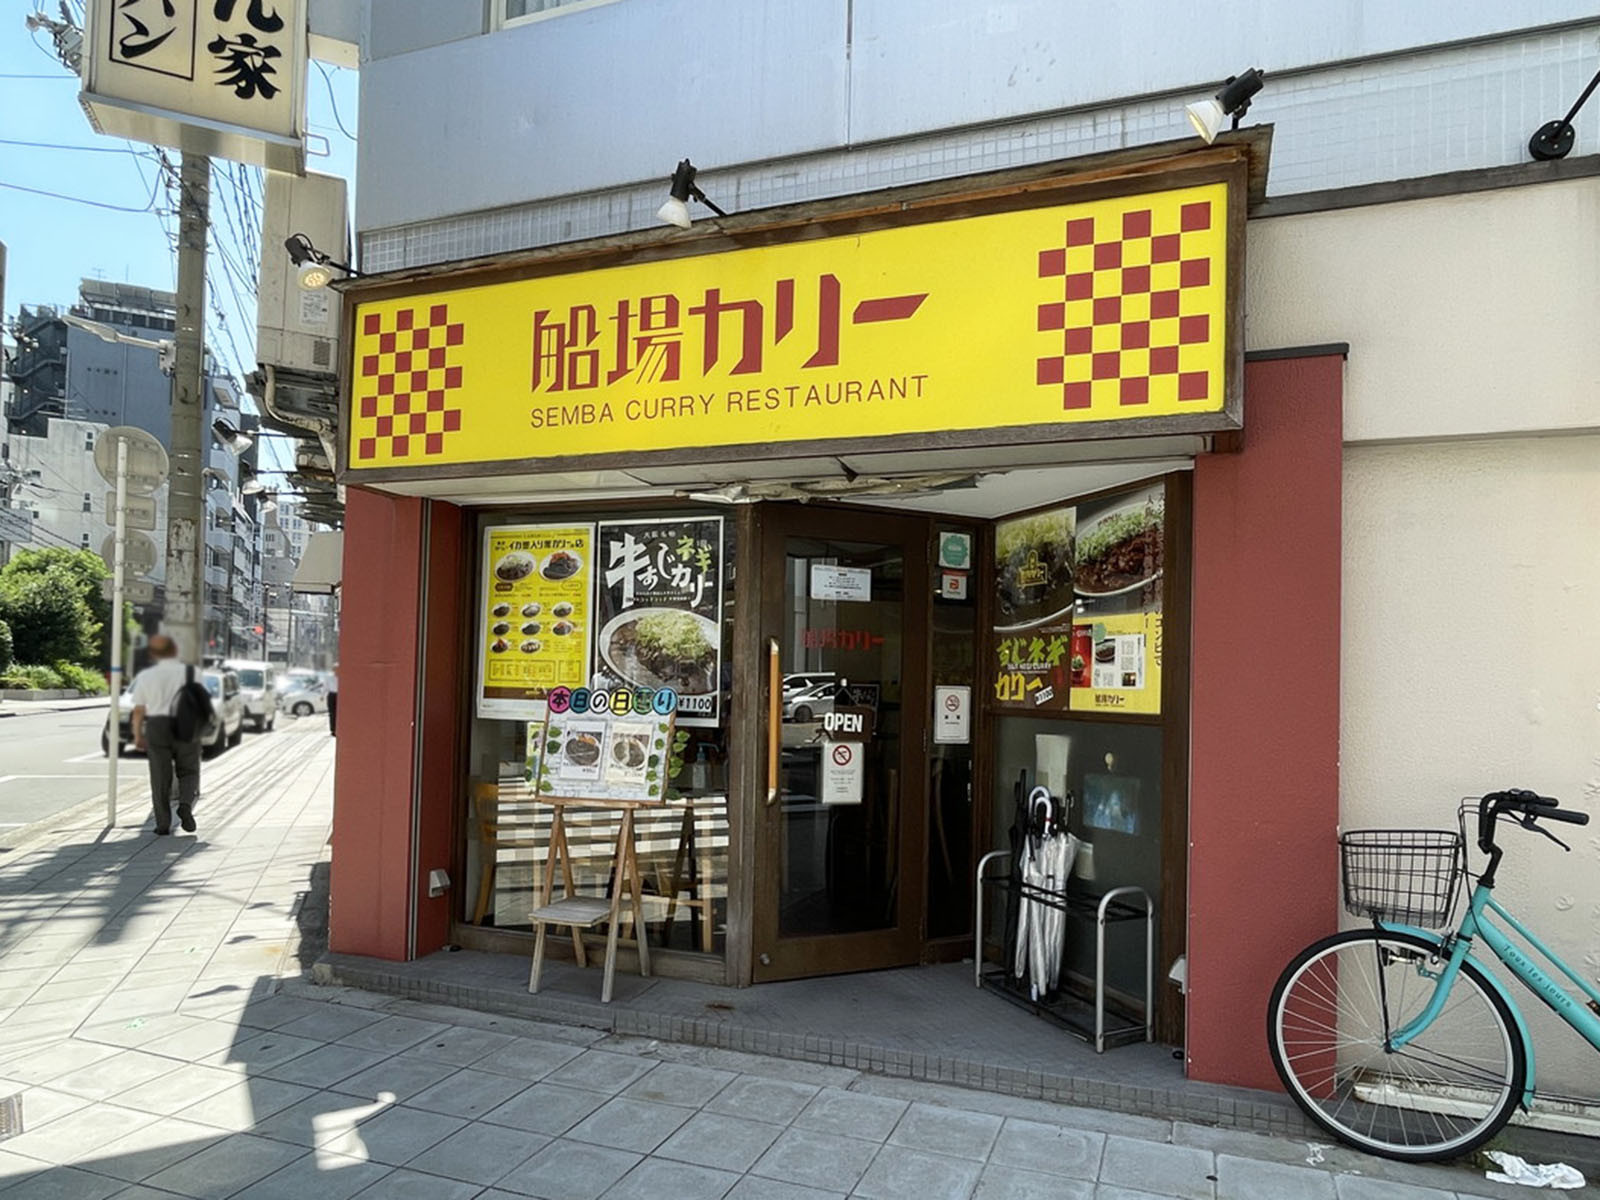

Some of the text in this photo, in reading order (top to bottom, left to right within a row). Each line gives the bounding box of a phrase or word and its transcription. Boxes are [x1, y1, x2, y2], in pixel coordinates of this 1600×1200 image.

[531, 273, 930, 393] 船場カリー
[531, 375, 929, 429] SEMBA CURRY RESTAURANT
[824, 712, 863, 733] OPEN
